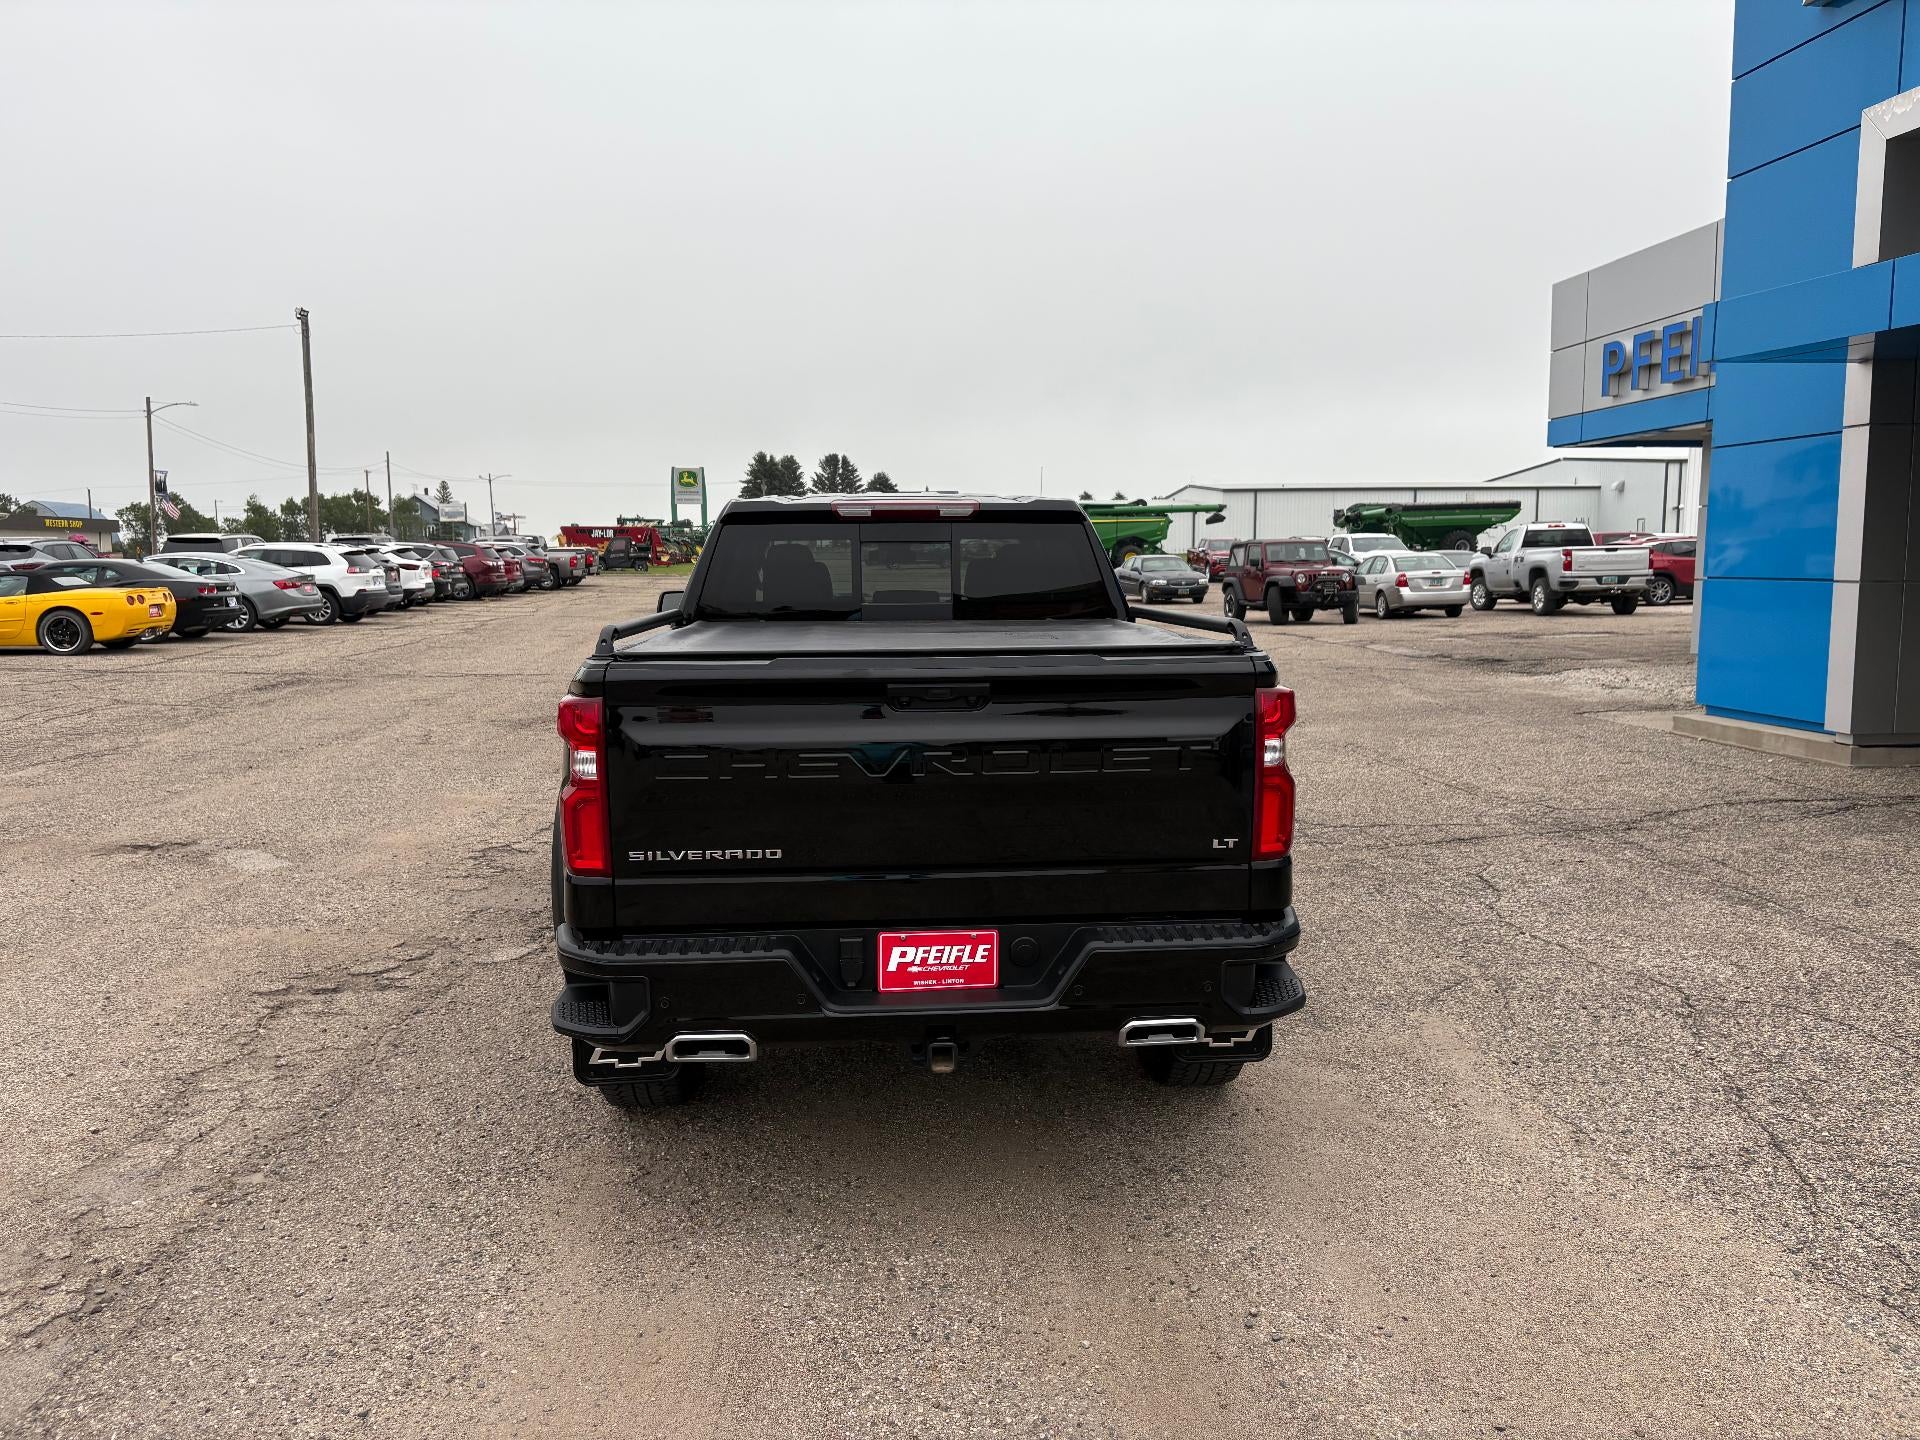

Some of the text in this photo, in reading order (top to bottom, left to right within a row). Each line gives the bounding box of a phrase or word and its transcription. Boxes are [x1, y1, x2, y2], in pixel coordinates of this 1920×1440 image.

[1601, 316, 1716, 397] PFEI
[69, 520, 83, 528] SHOP
[654, 740, 1220, 779] CHEVROLET
[1212, 838, 1239, 849] LT
[628, 849, 782, 862] SILVERADO
[886, 944, 992, 972] PFEIFLE
[922, 964, 970, 972] CHEVROLET
